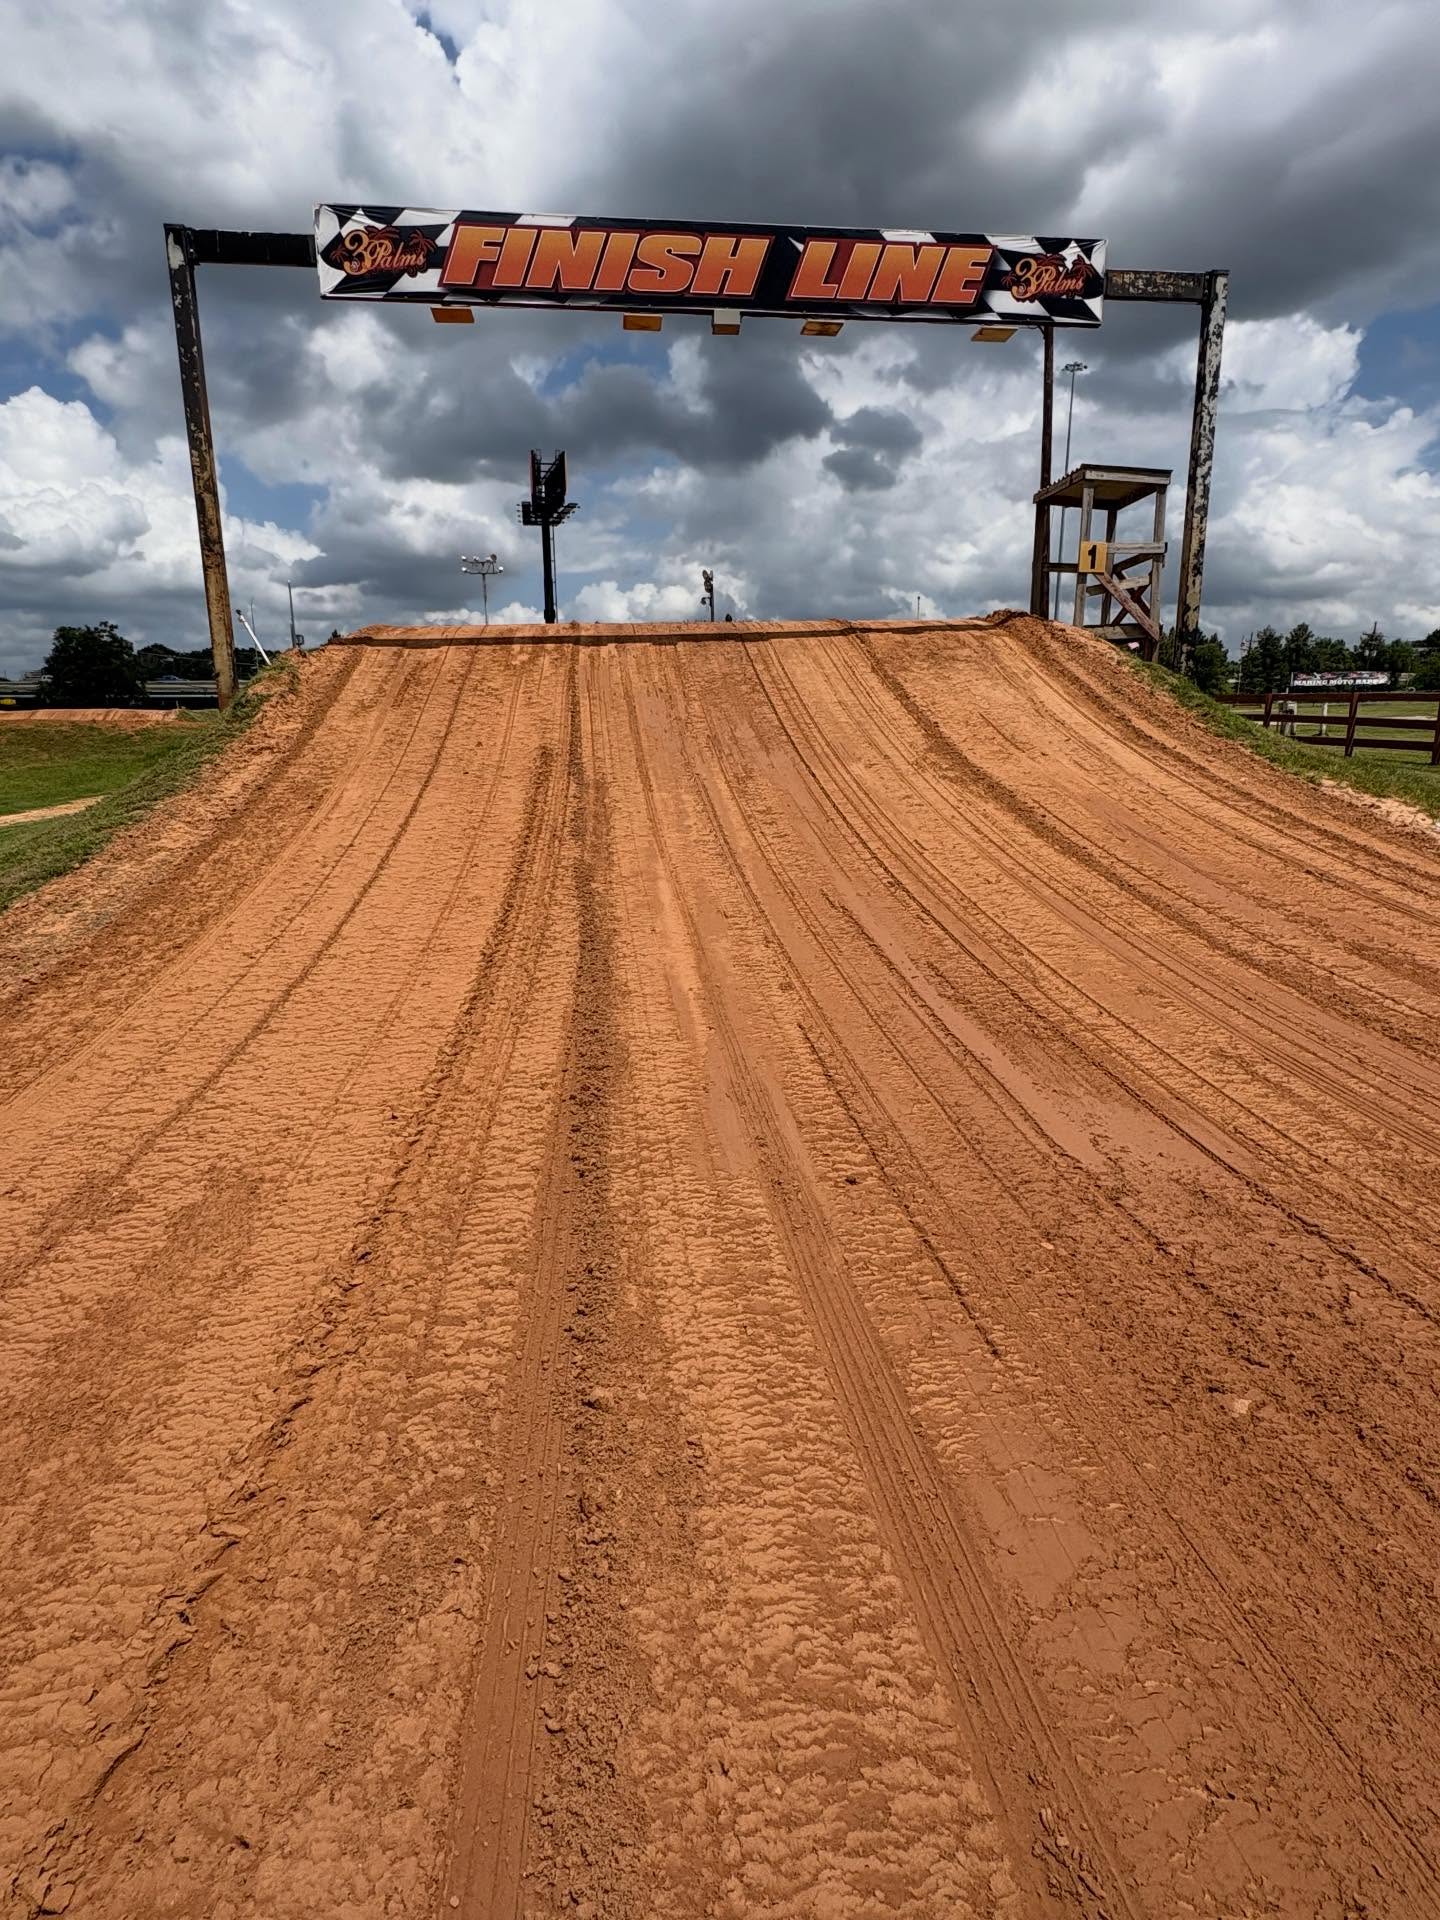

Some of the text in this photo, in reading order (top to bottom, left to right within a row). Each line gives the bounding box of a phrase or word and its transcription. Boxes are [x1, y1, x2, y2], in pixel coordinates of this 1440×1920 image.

[344, 230, 425, 275] 3 Palms
[443, 226, 992, 303] FINISH LINE
[1011, 258, 1084, 298] 3 Palms
[1088, 545, 1097, 569] 1
